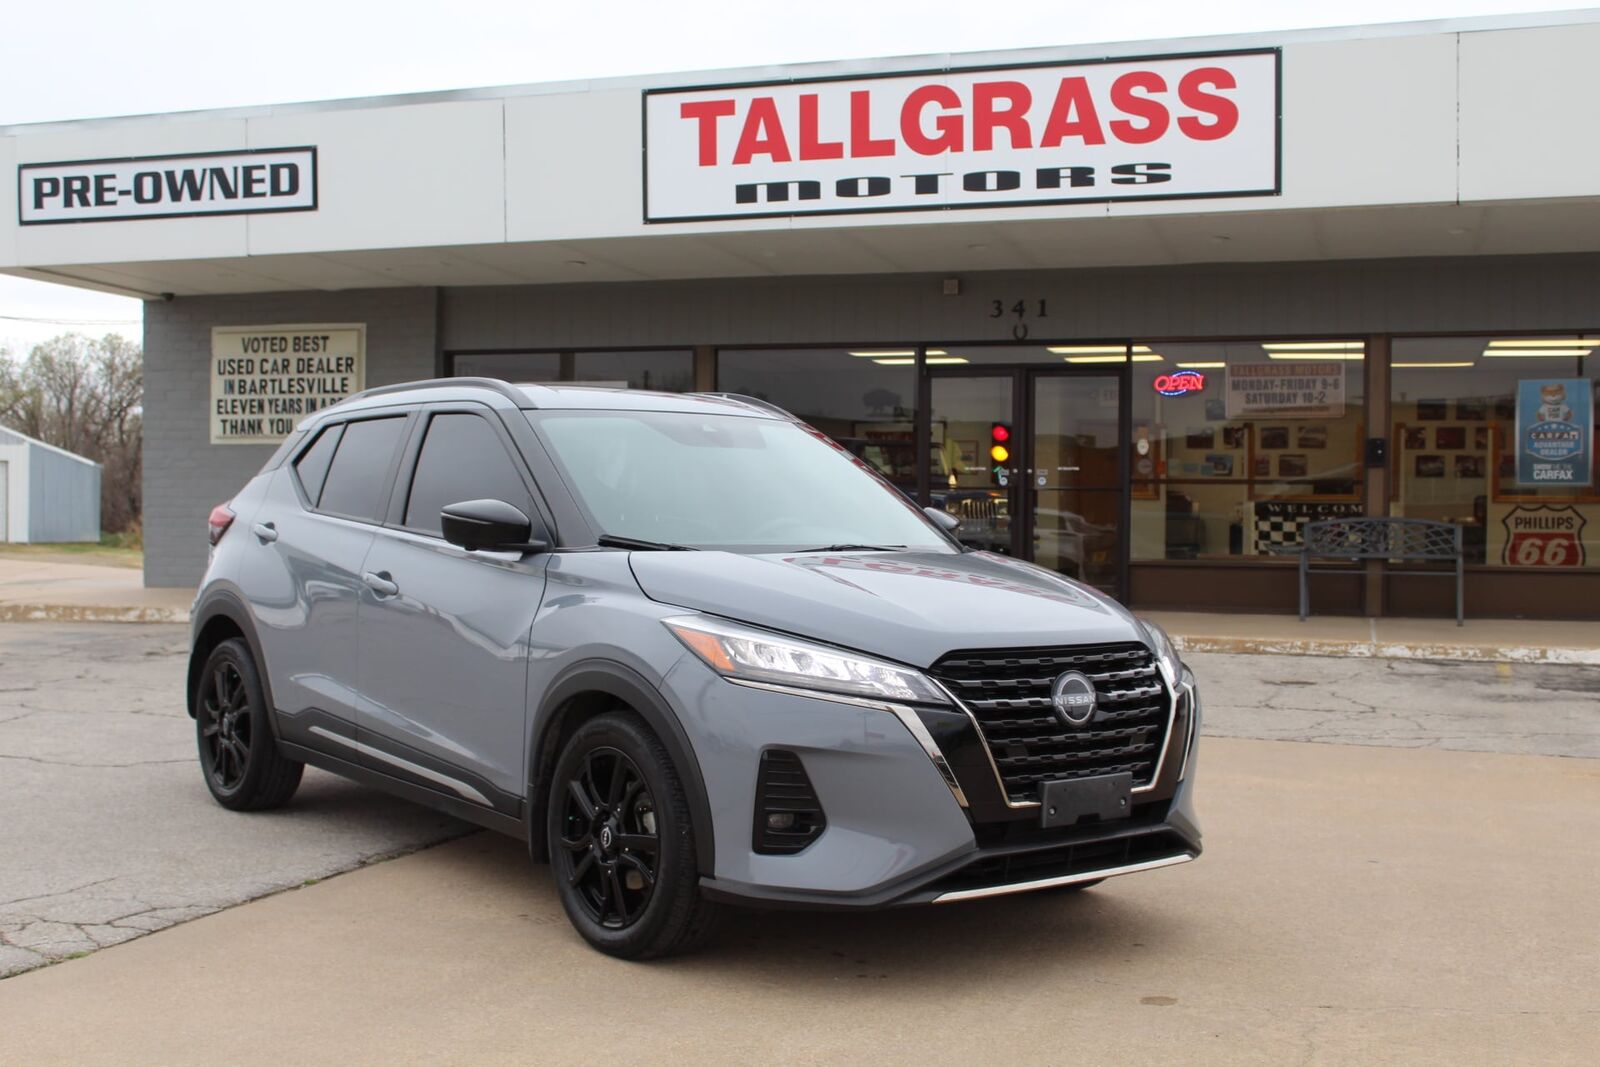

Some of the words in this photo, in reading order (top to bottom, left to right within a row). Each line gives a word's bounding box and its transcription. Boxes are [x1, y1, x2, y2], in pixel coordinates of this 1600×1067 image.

[680, 67, 1240, 167] TALLGRASS
[33, 162, 300, 210] PRE-OWNED
[989, 299, 1048, 318] 341
[242, 337, 288, 353] VOTED
[293, 336, 329, 352] BEST
[218, 359, 254, 375] USED
[260, 358, 290, 374] CAR
[297, 357, 354, 374] DEALER
[224, 379, 235, 394] IN
[238, 377, 349, 395] BARTLESVILLE
[1154, 375, 1205, 391] OPEN
[217, 398, 264, 415] ELEVEN
[268, 398, 302, 414] YEARS
[305, 397, 317, 414] IN
[1245, 392, 1297, 404] SATURDAY
[221, 419, 263, 435] THANK
[269, 418, 293, 434] YOU
[1533, 470, 1573, 480] CARFAX
[1515, 516, 1574, 530] PHILLIPS
[1517, 537, 1570, 566] 66
[1055, 696, 1095, 705] NISSAN
